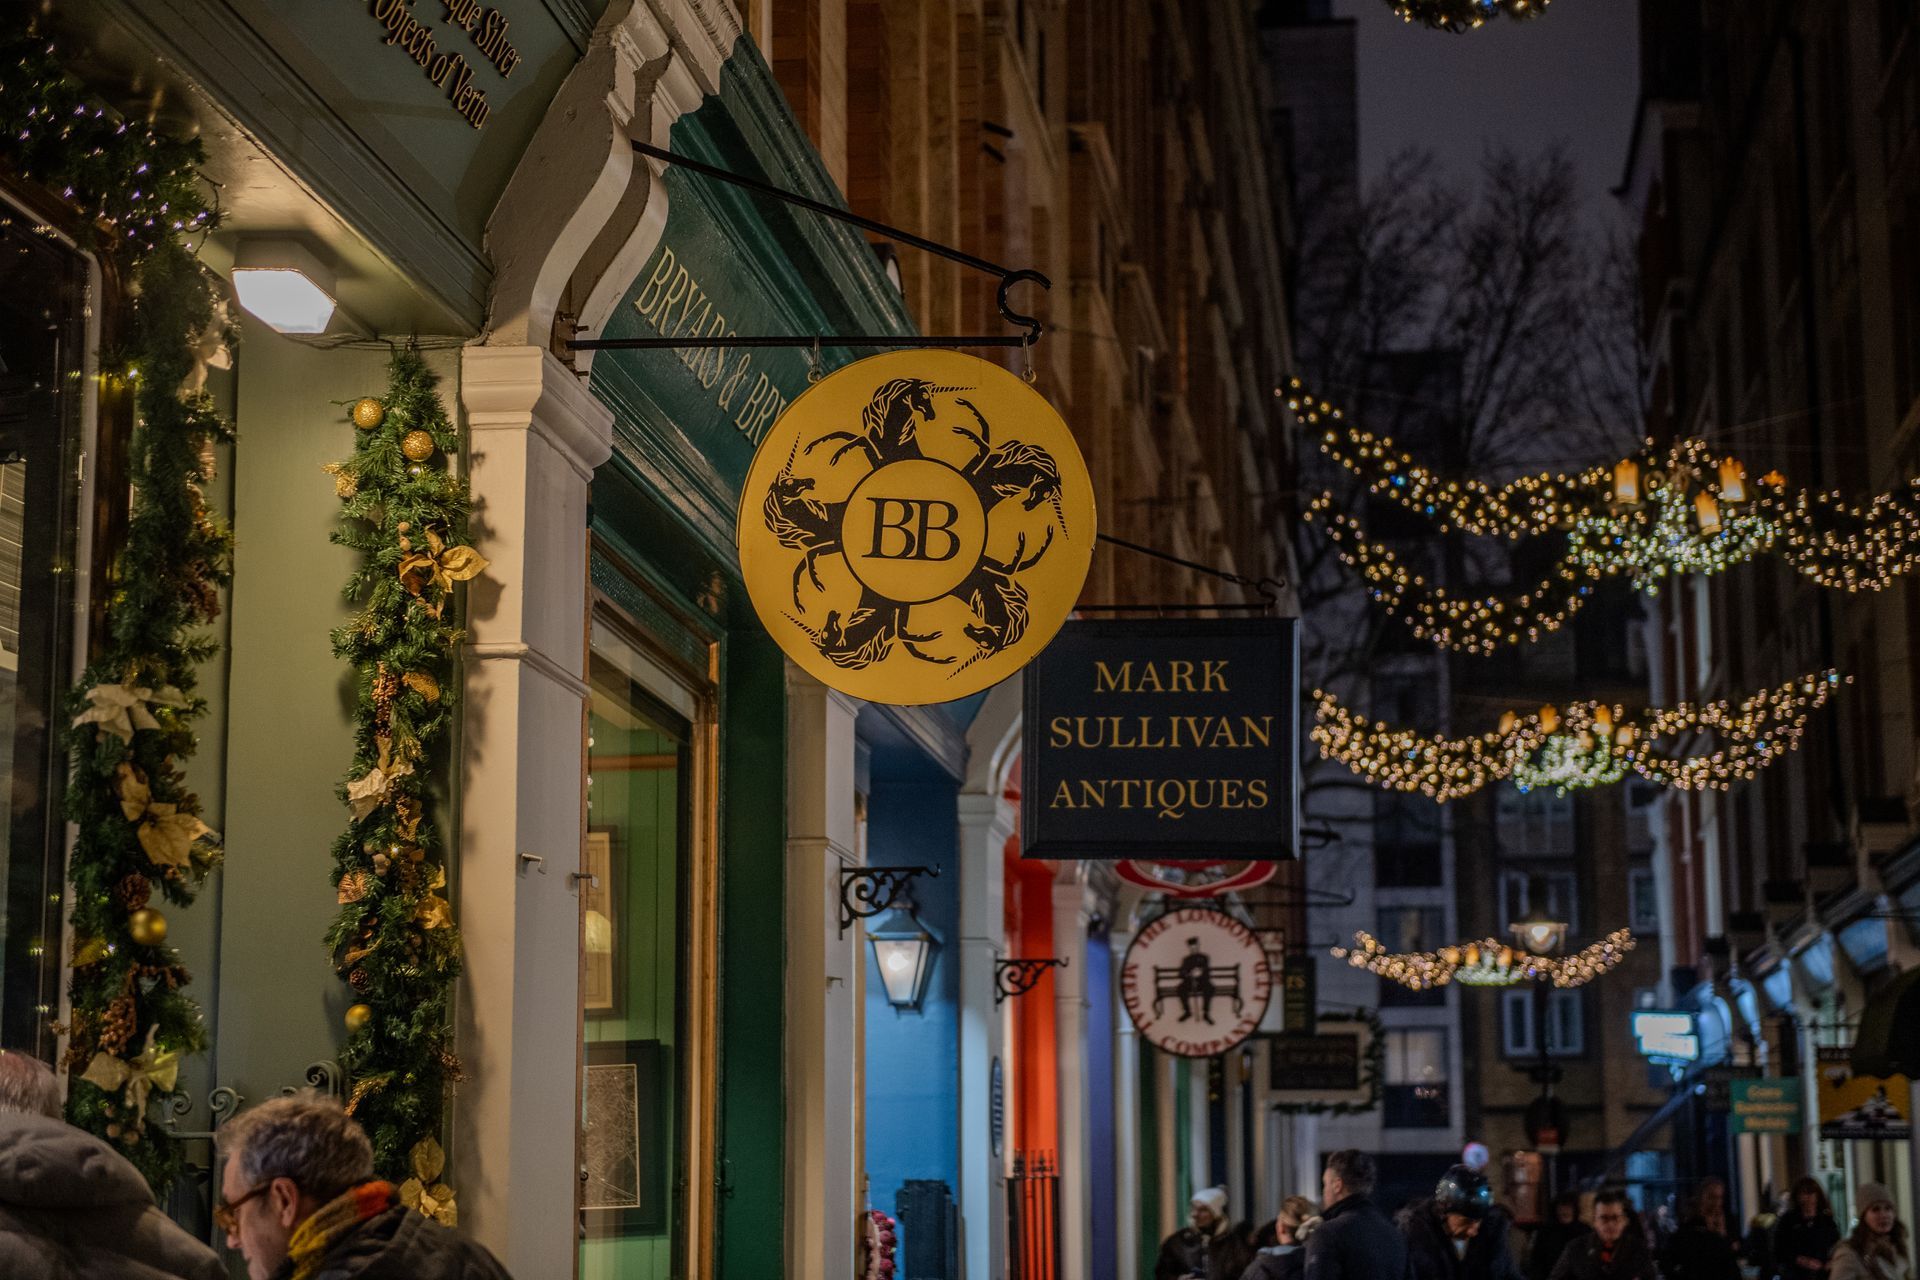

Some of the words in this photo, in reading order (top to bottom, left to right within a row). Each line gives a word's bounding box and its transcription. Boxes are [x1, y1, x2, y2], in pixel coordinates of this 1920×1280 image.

[441, 0, 482, 32] que
[475, 9, 522, 79] Silver
[431, 54, 463, 88] of
[452, 61, 490, 130] Vertu
[634, 245, 737, 390] BRYARS
[718, 352, 751, 413] &
[862, 497, 961, 562] BB
[1093, 659, 1231, 694] MARK
[1049, 715, 1275, 749] SULLIVAN
[1049, 778, 1269, 820] ANTIQUES
[1136, 920, 1171, 948] THE
[1175, 910, 1257, 948] LONDON
[1122, 963, 1152, 1032] MEDAL
[1160, 1012, 1259, 1056] COMPANY
